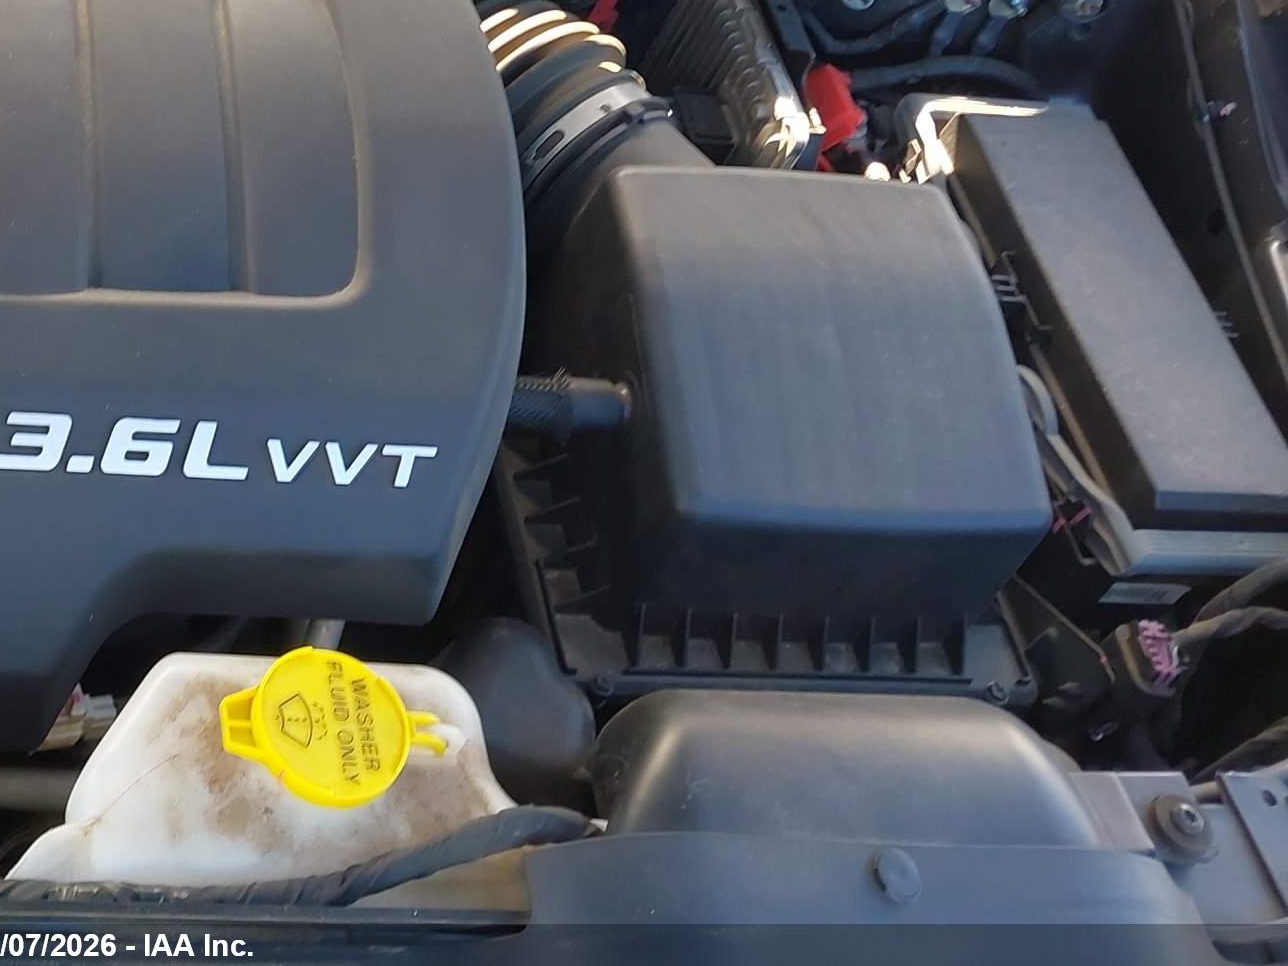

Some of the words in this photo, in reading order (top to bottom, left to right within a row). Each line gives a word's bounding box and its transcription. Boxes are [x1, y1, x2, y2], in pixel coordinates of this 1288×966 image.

[266, 438, 438, 487] VVT
[327, 661, 350, 722] FLUID
[352, 678, 381, 772] WASHER
[337, 730, 360, 786] ONLY
